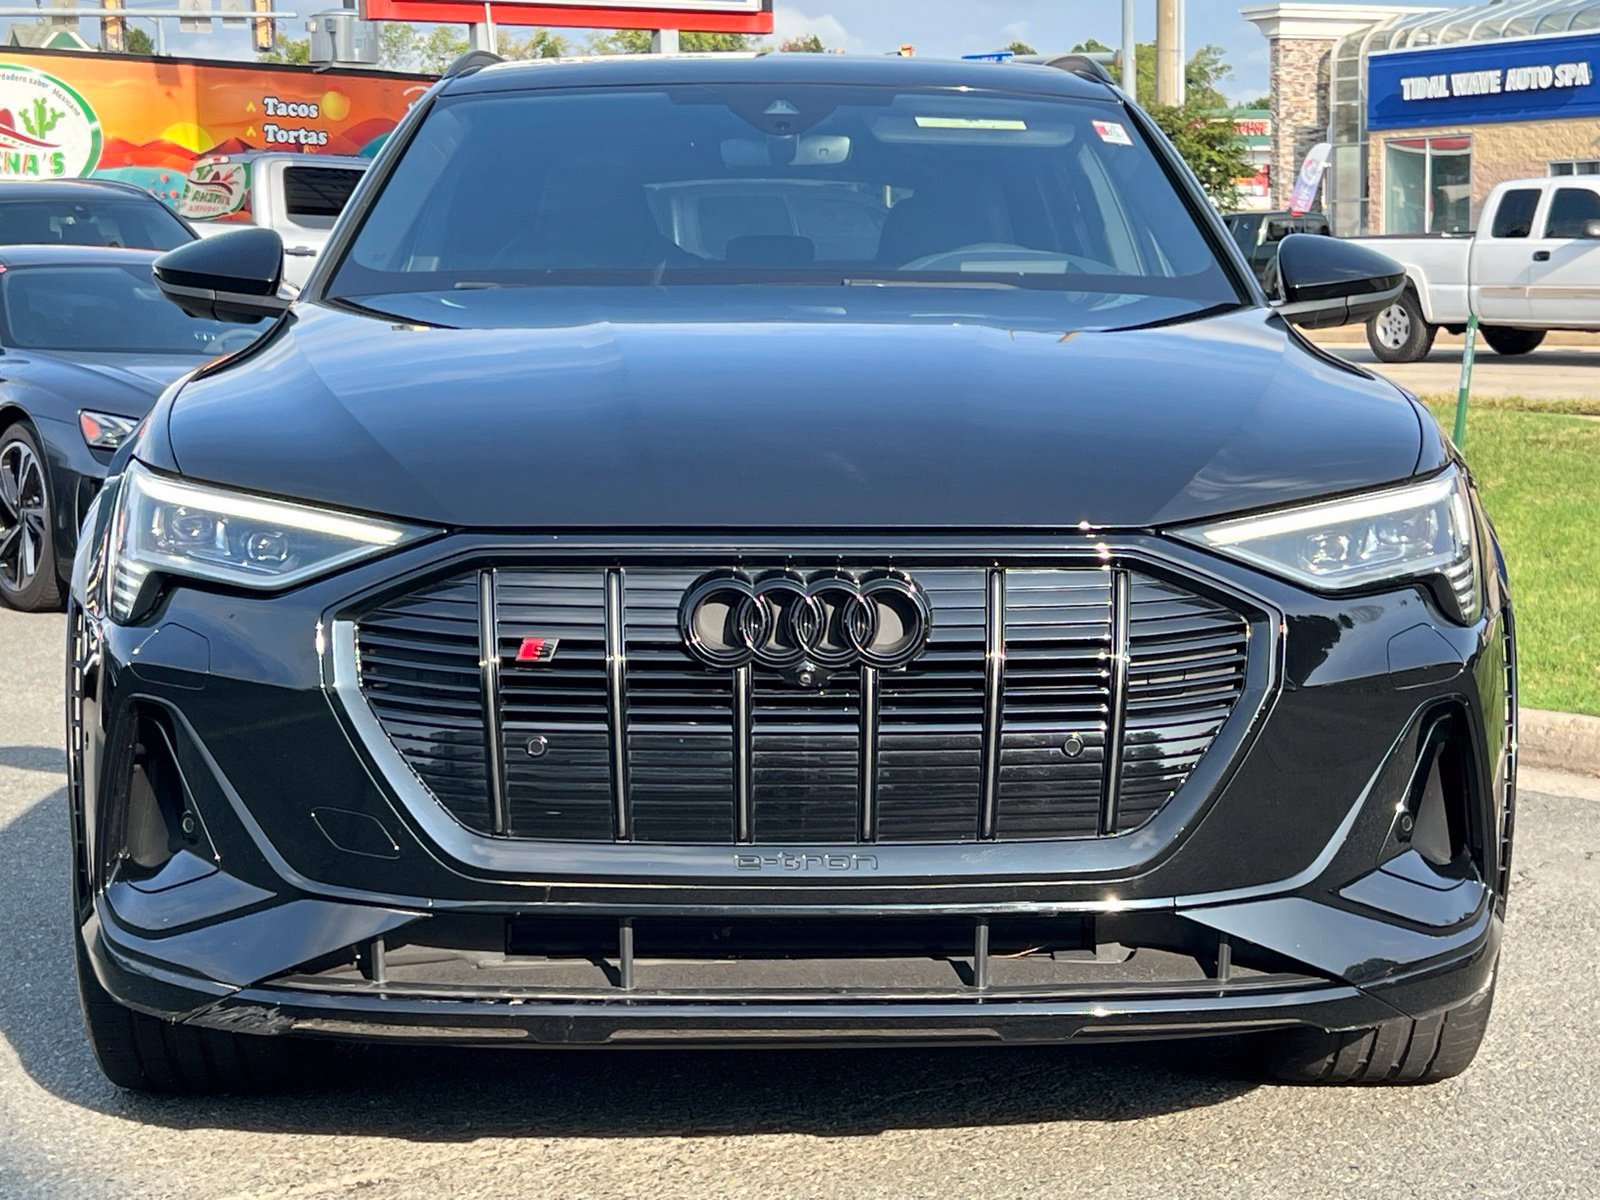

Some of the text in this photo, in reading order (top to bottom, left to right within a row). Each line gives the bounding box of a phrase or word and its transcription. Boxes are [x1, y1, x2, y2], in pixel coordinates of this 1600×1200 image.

[1401, 62, 1590, 101] TIDAL WAVE AUTO SPA
[263, 96, 319, 119] Tacos
[263, 123, 328, 146] Tortas
[0, 151, 65, 177] NA'S
[734, 852, 878, 871] e-tron
